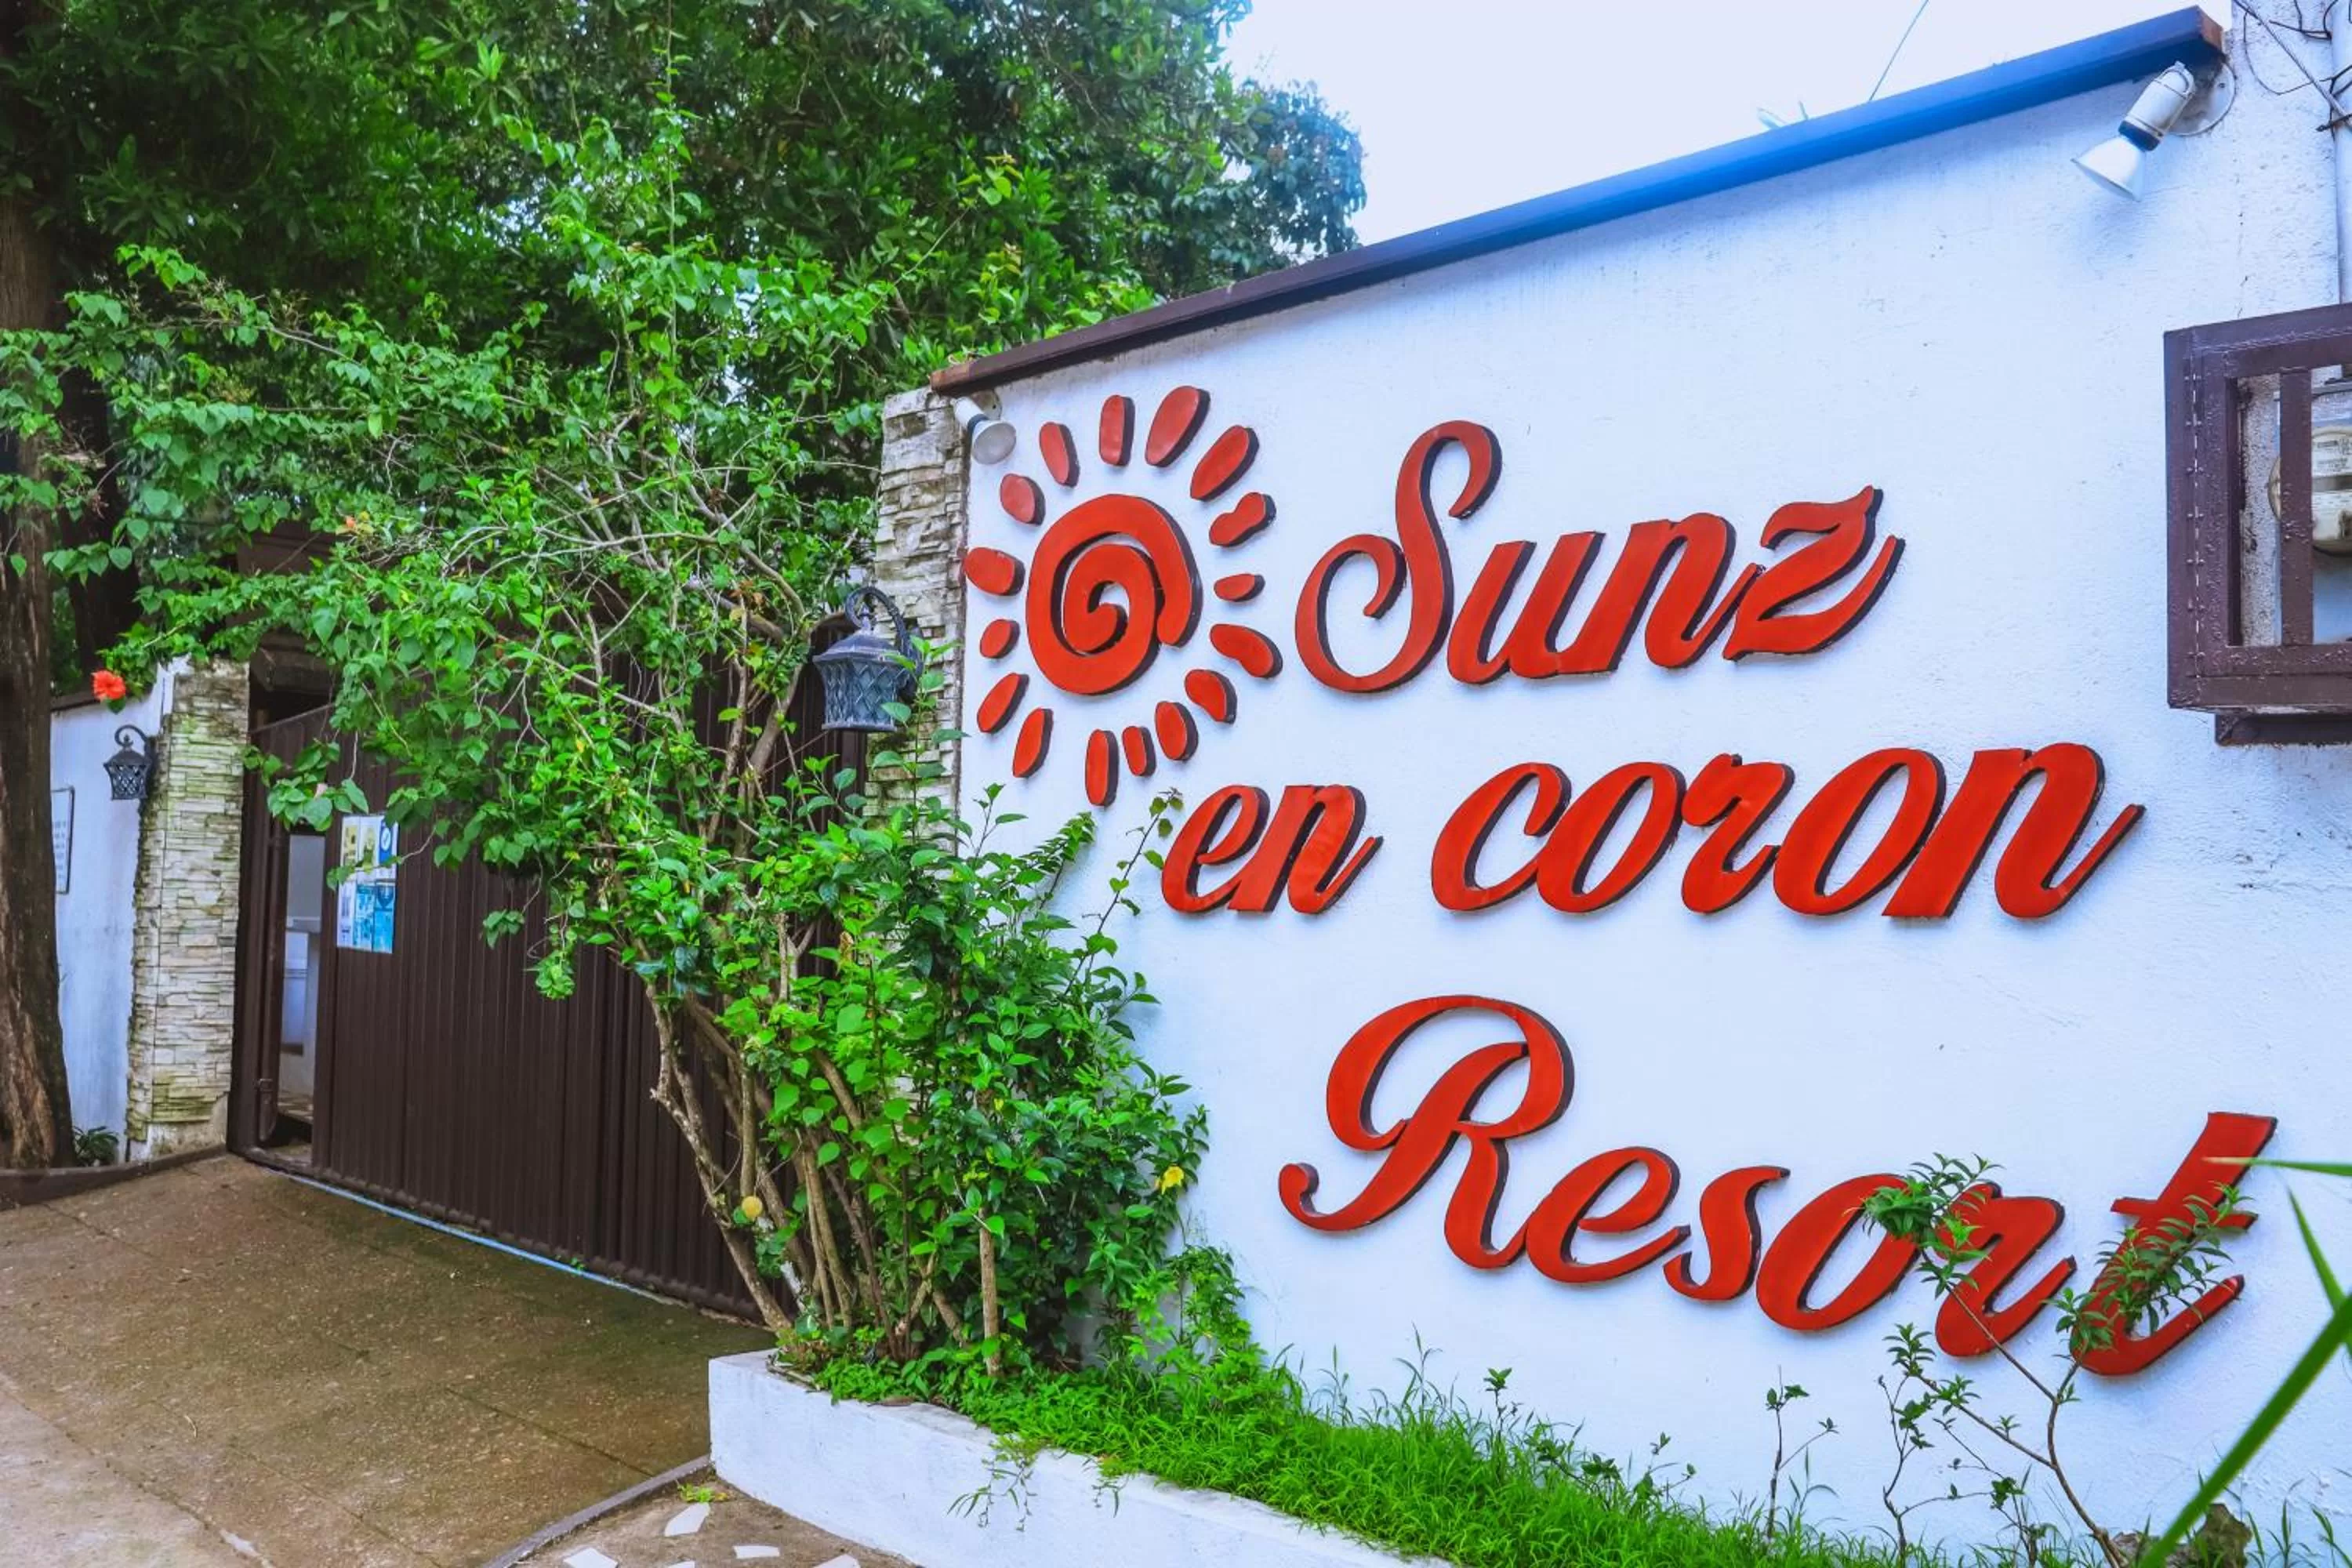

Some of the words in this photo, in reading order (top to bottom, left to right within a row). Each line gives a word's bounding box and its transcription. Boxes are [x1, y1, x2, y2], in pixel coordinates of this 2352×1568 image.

[1294, 420, 1904, 694] Sunz
[1161, 784, 1383, 914] en
[1431, 742, 2145, 920] coron
[1278, 994, 2278, 1376] Resort
